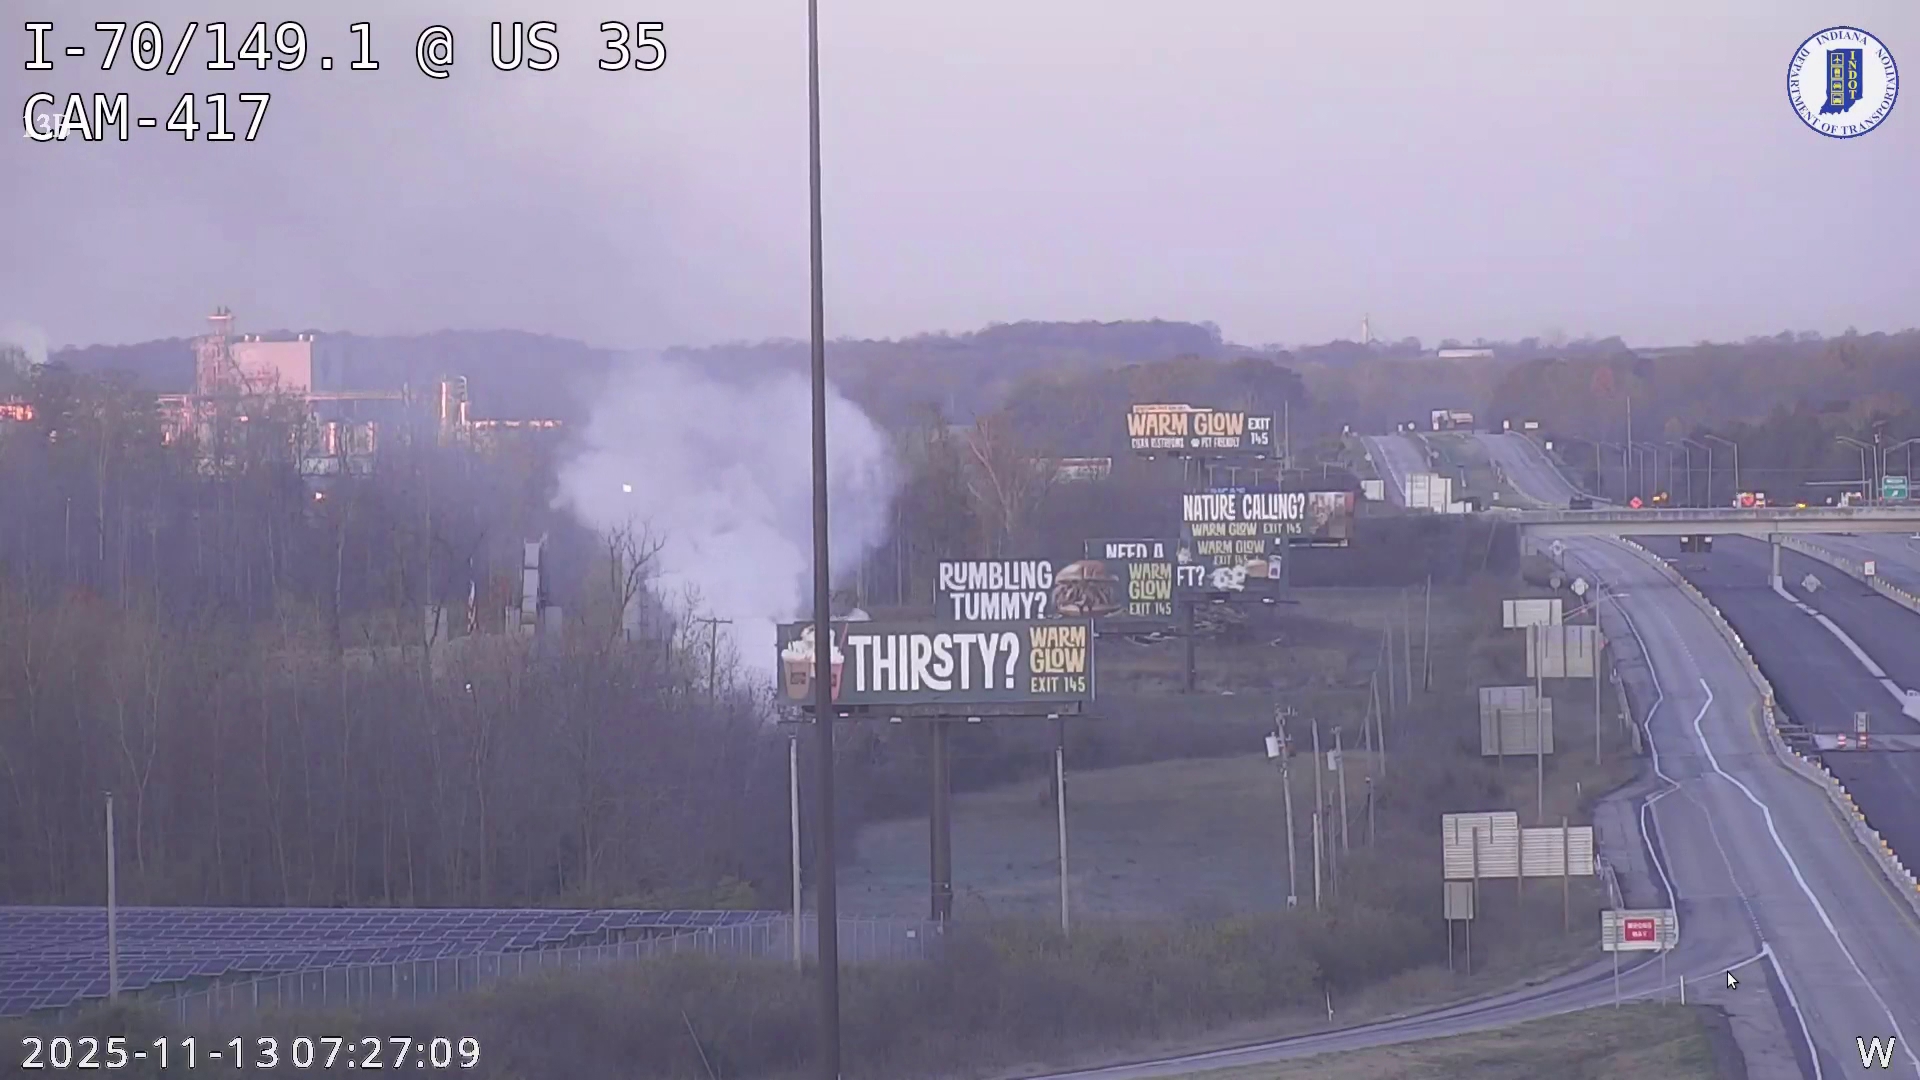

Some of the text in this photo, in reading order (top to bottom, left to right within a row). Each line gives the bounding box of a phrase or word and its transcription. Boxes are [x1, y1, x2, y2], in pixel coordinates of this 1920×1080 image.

[1127, 412, 1244, 436] WARM GLOW
[1248, 417, 1271, 431] EXIT
[1250, 431, 1269, 445] 145
[1183, 492, 1305, 521] NATURE CALLING?
[1191, 522, 1301, 536] WARM GLOW EXIT 145
[1197, 540, 1233, 555] WARM
[939, 560, 1052, 591] RUMBLING
[1128, 563, 1172, 580] WARM
[1128, 580, 1172, 600] GLOW
[950, 592, 1047, 621] TUMMY?
[1129, 602, 1172, 616] EXIT 145
[1029, 626, 1086, 649] WARM
[848, 632, 1020, 692] THIRSTY?
[1029, 648, 1086, 673] GLOW
[1031, 676, 1086, 693] EXIT 145
